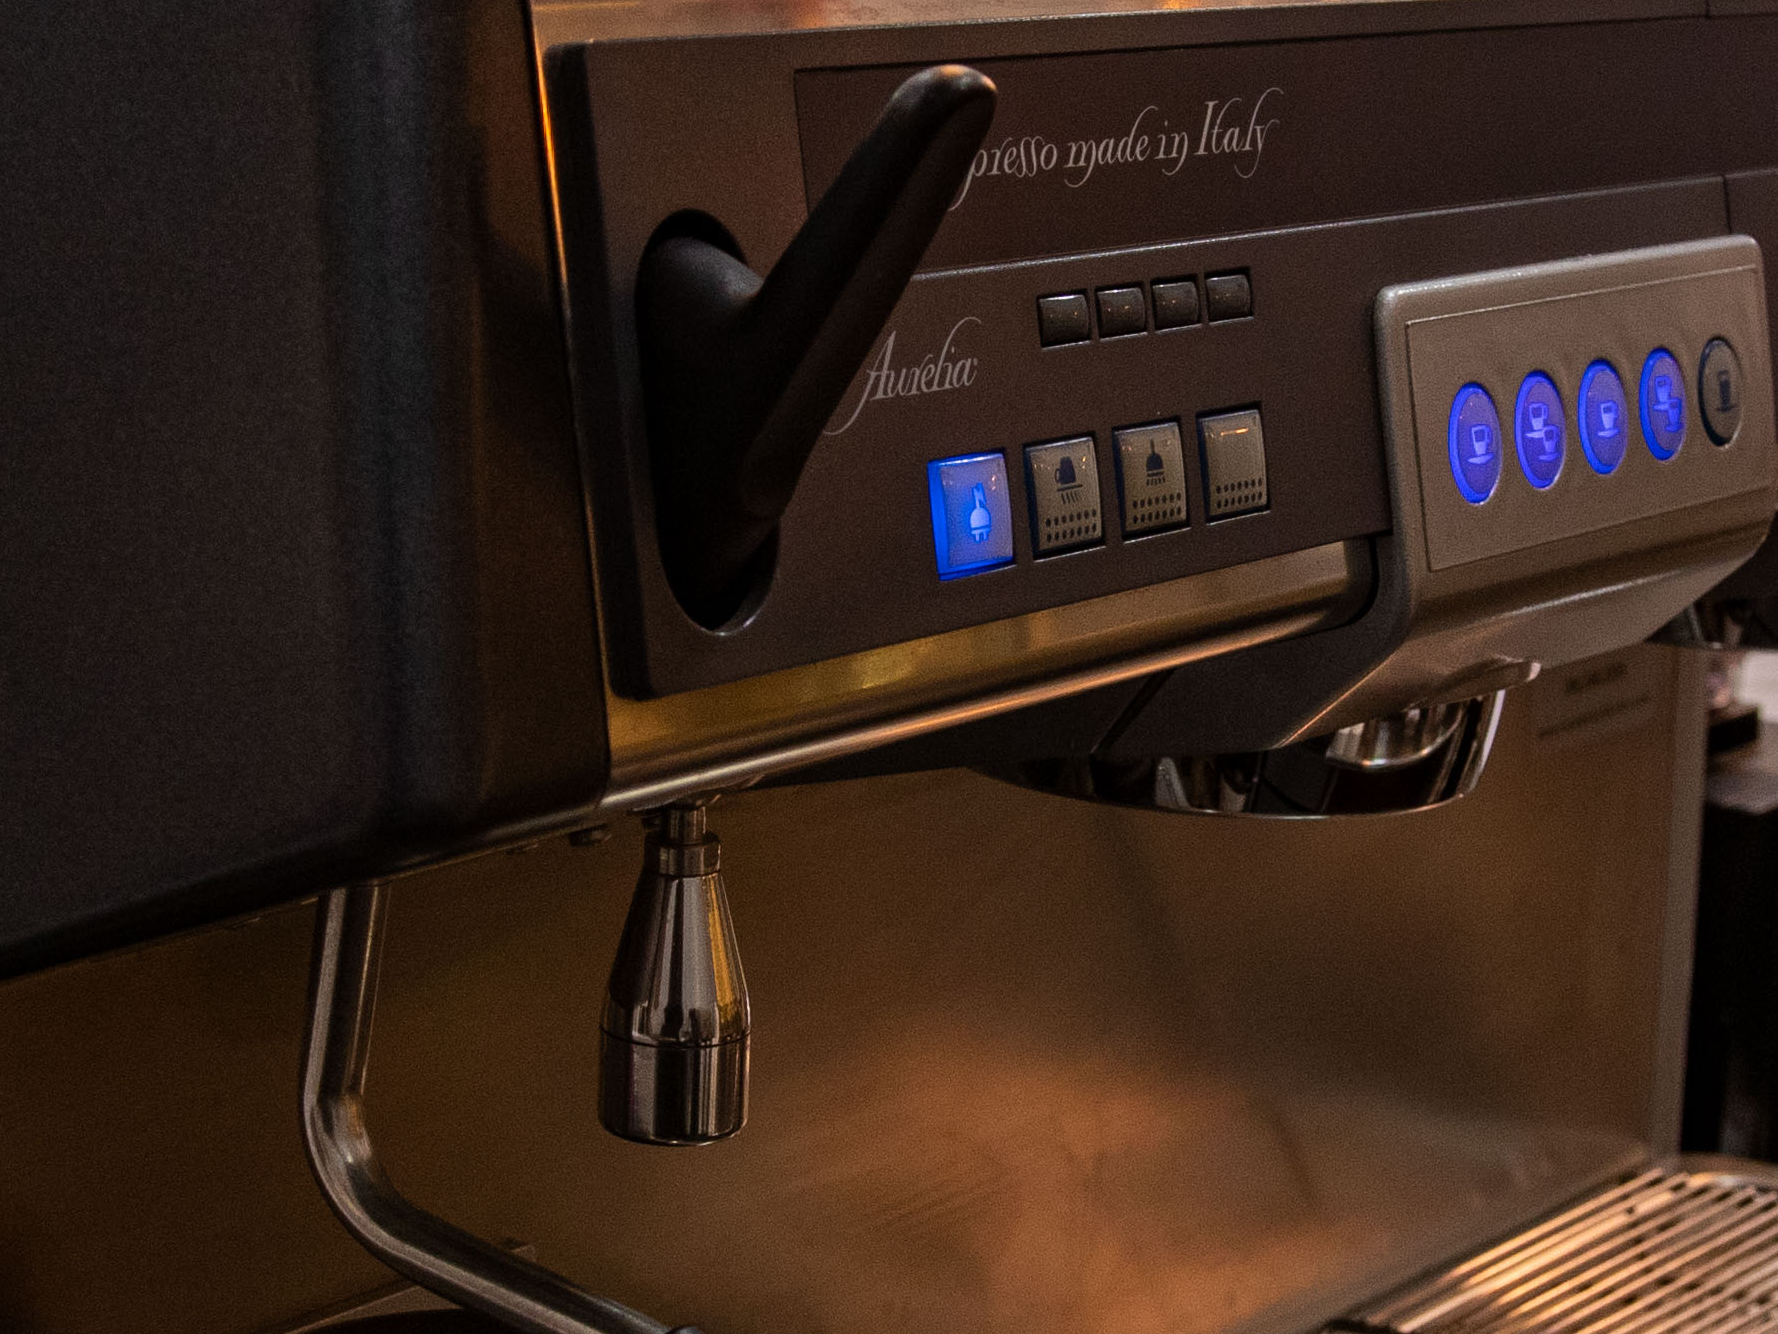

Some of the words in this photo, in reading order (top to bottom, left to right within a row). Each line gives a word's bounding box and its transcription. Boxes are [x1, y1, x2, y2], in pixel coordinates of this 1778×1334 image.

[948, 135, 1058, 211] presso
[1063, 105, 1159, 187] made
[1154, 119, 1189, 176] in
[1193, 87, 1284, 179] Italy
[822, 316, 982, 435] Aurelia
